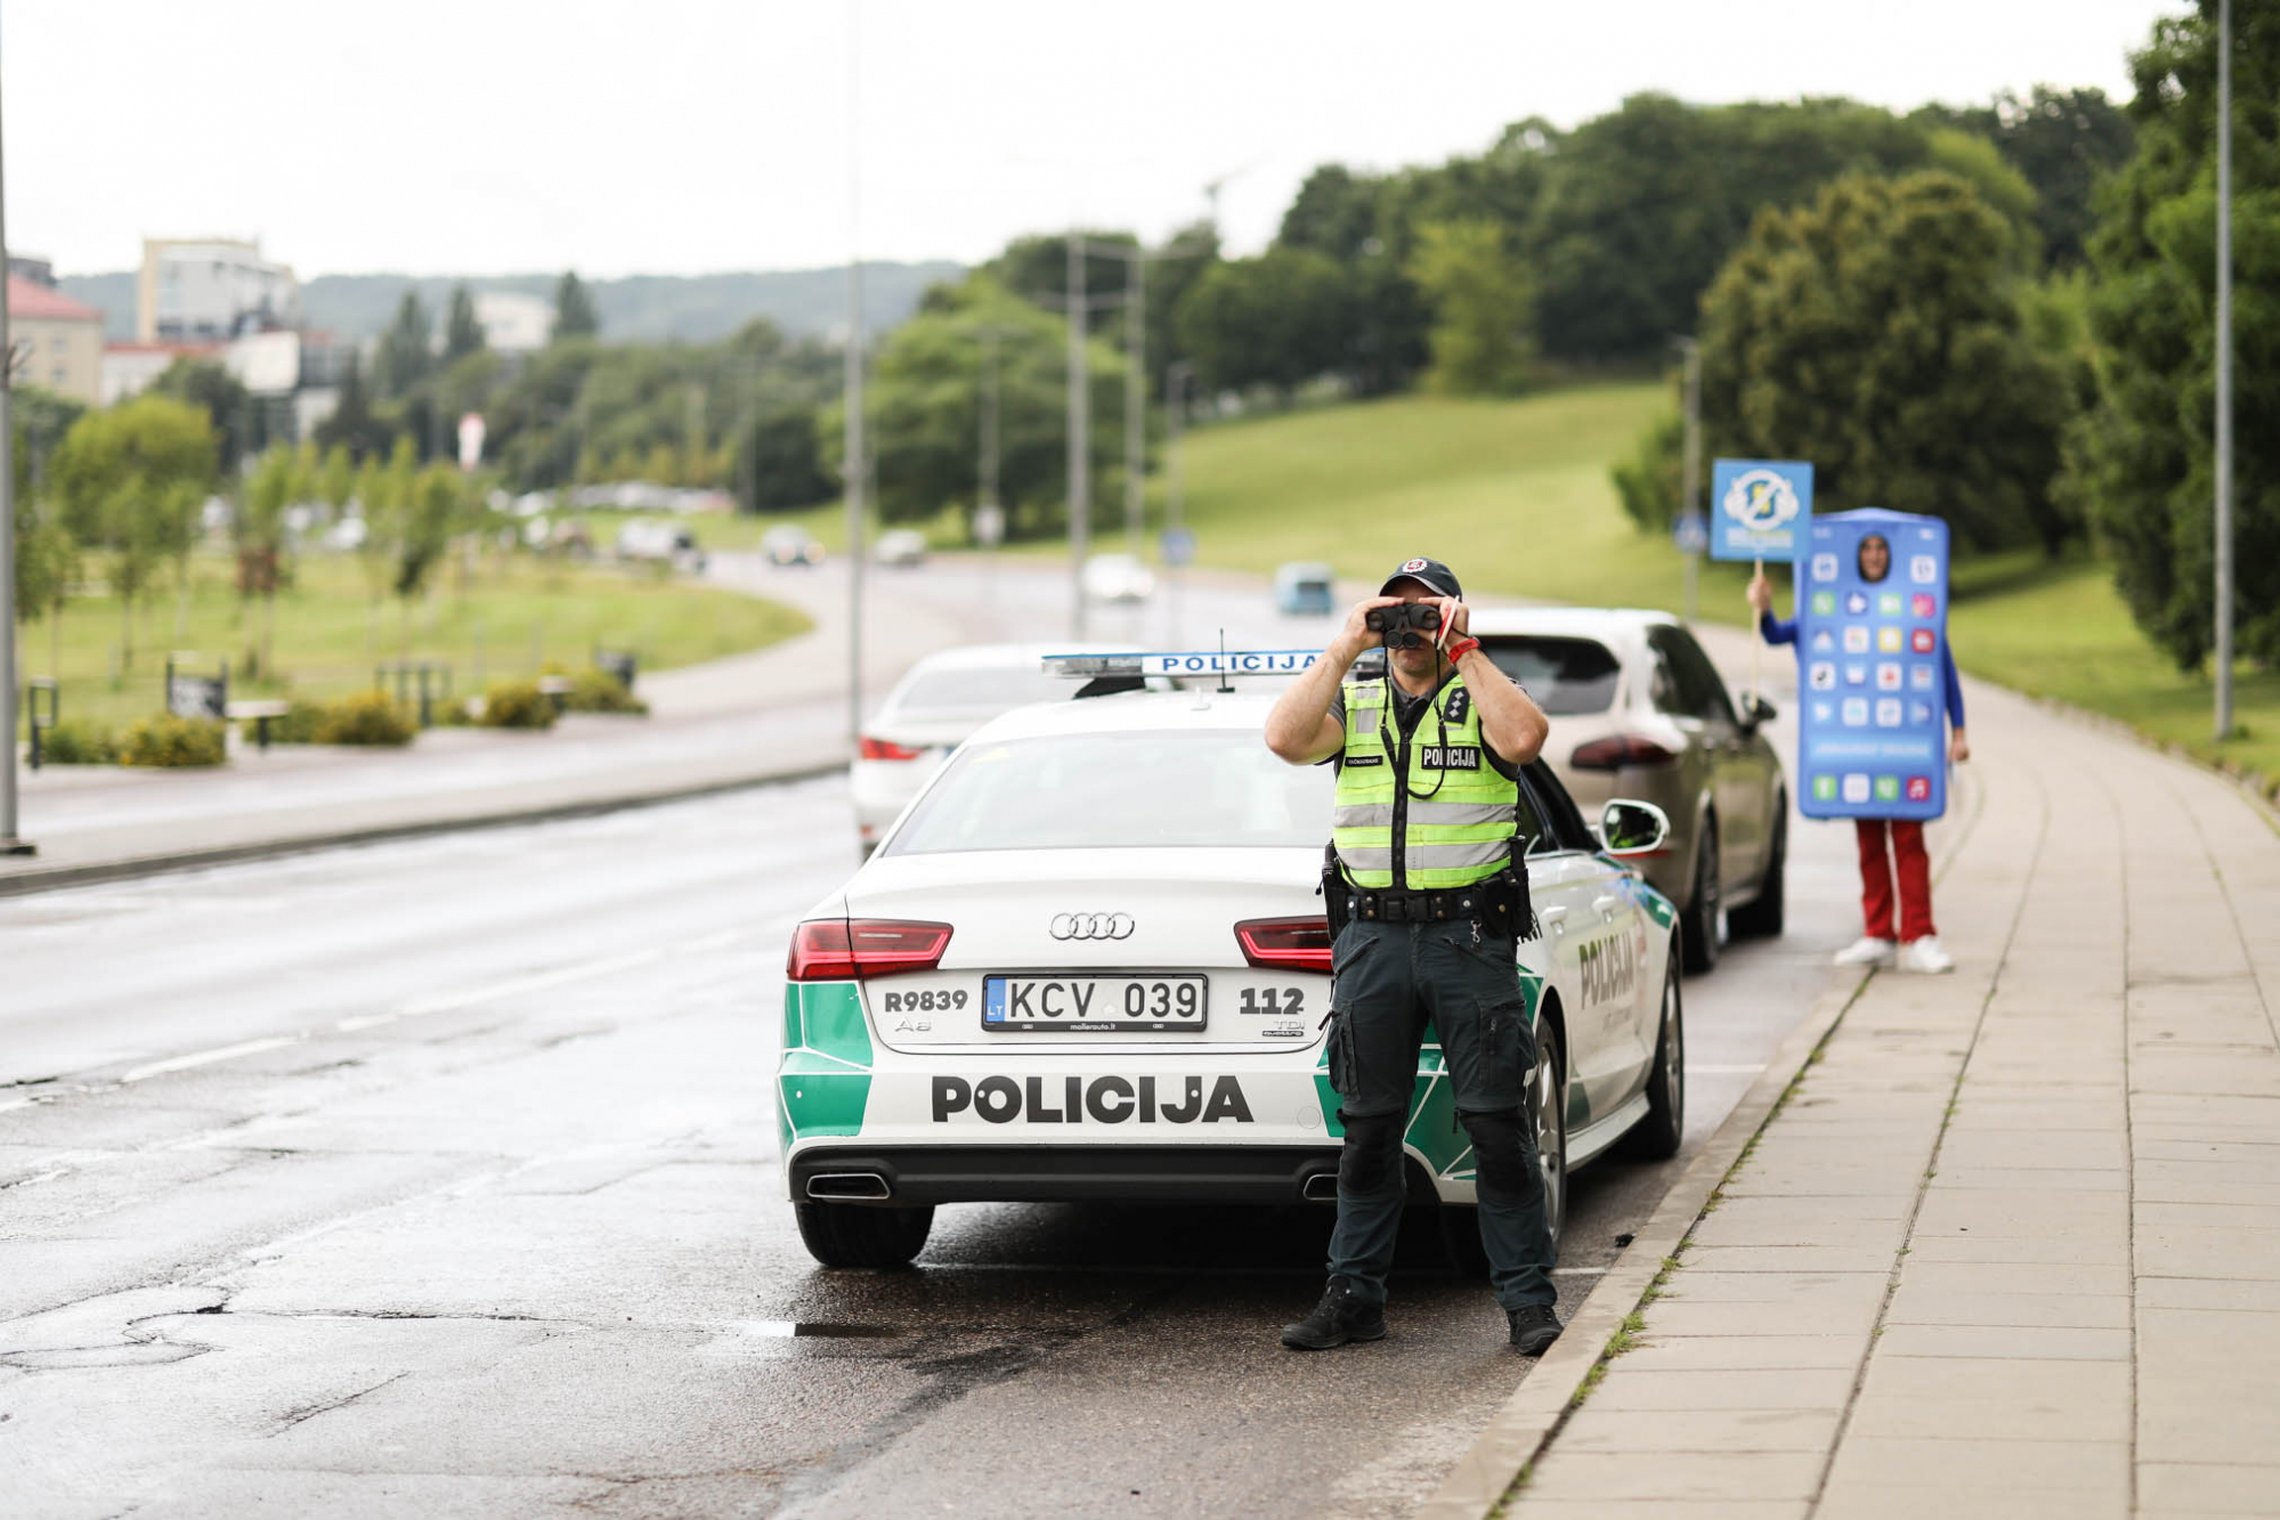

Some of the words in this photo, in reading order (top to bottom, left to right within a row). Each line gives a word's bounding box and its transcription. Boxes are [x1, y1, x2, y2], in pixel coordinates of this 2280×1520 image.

[1579, 930, 1634, 1010] POLICIJA
[885, 990, 968, 1012] R9839
[987, 1005, 1003, 1016] LT
[1010, 982, 1095, 1018] KCV
[1125, 982, 1197, 1018] 039
[1240, 988, 1304, 1014] 112
[932, 1075, 1254, 1124] POLICIJA
